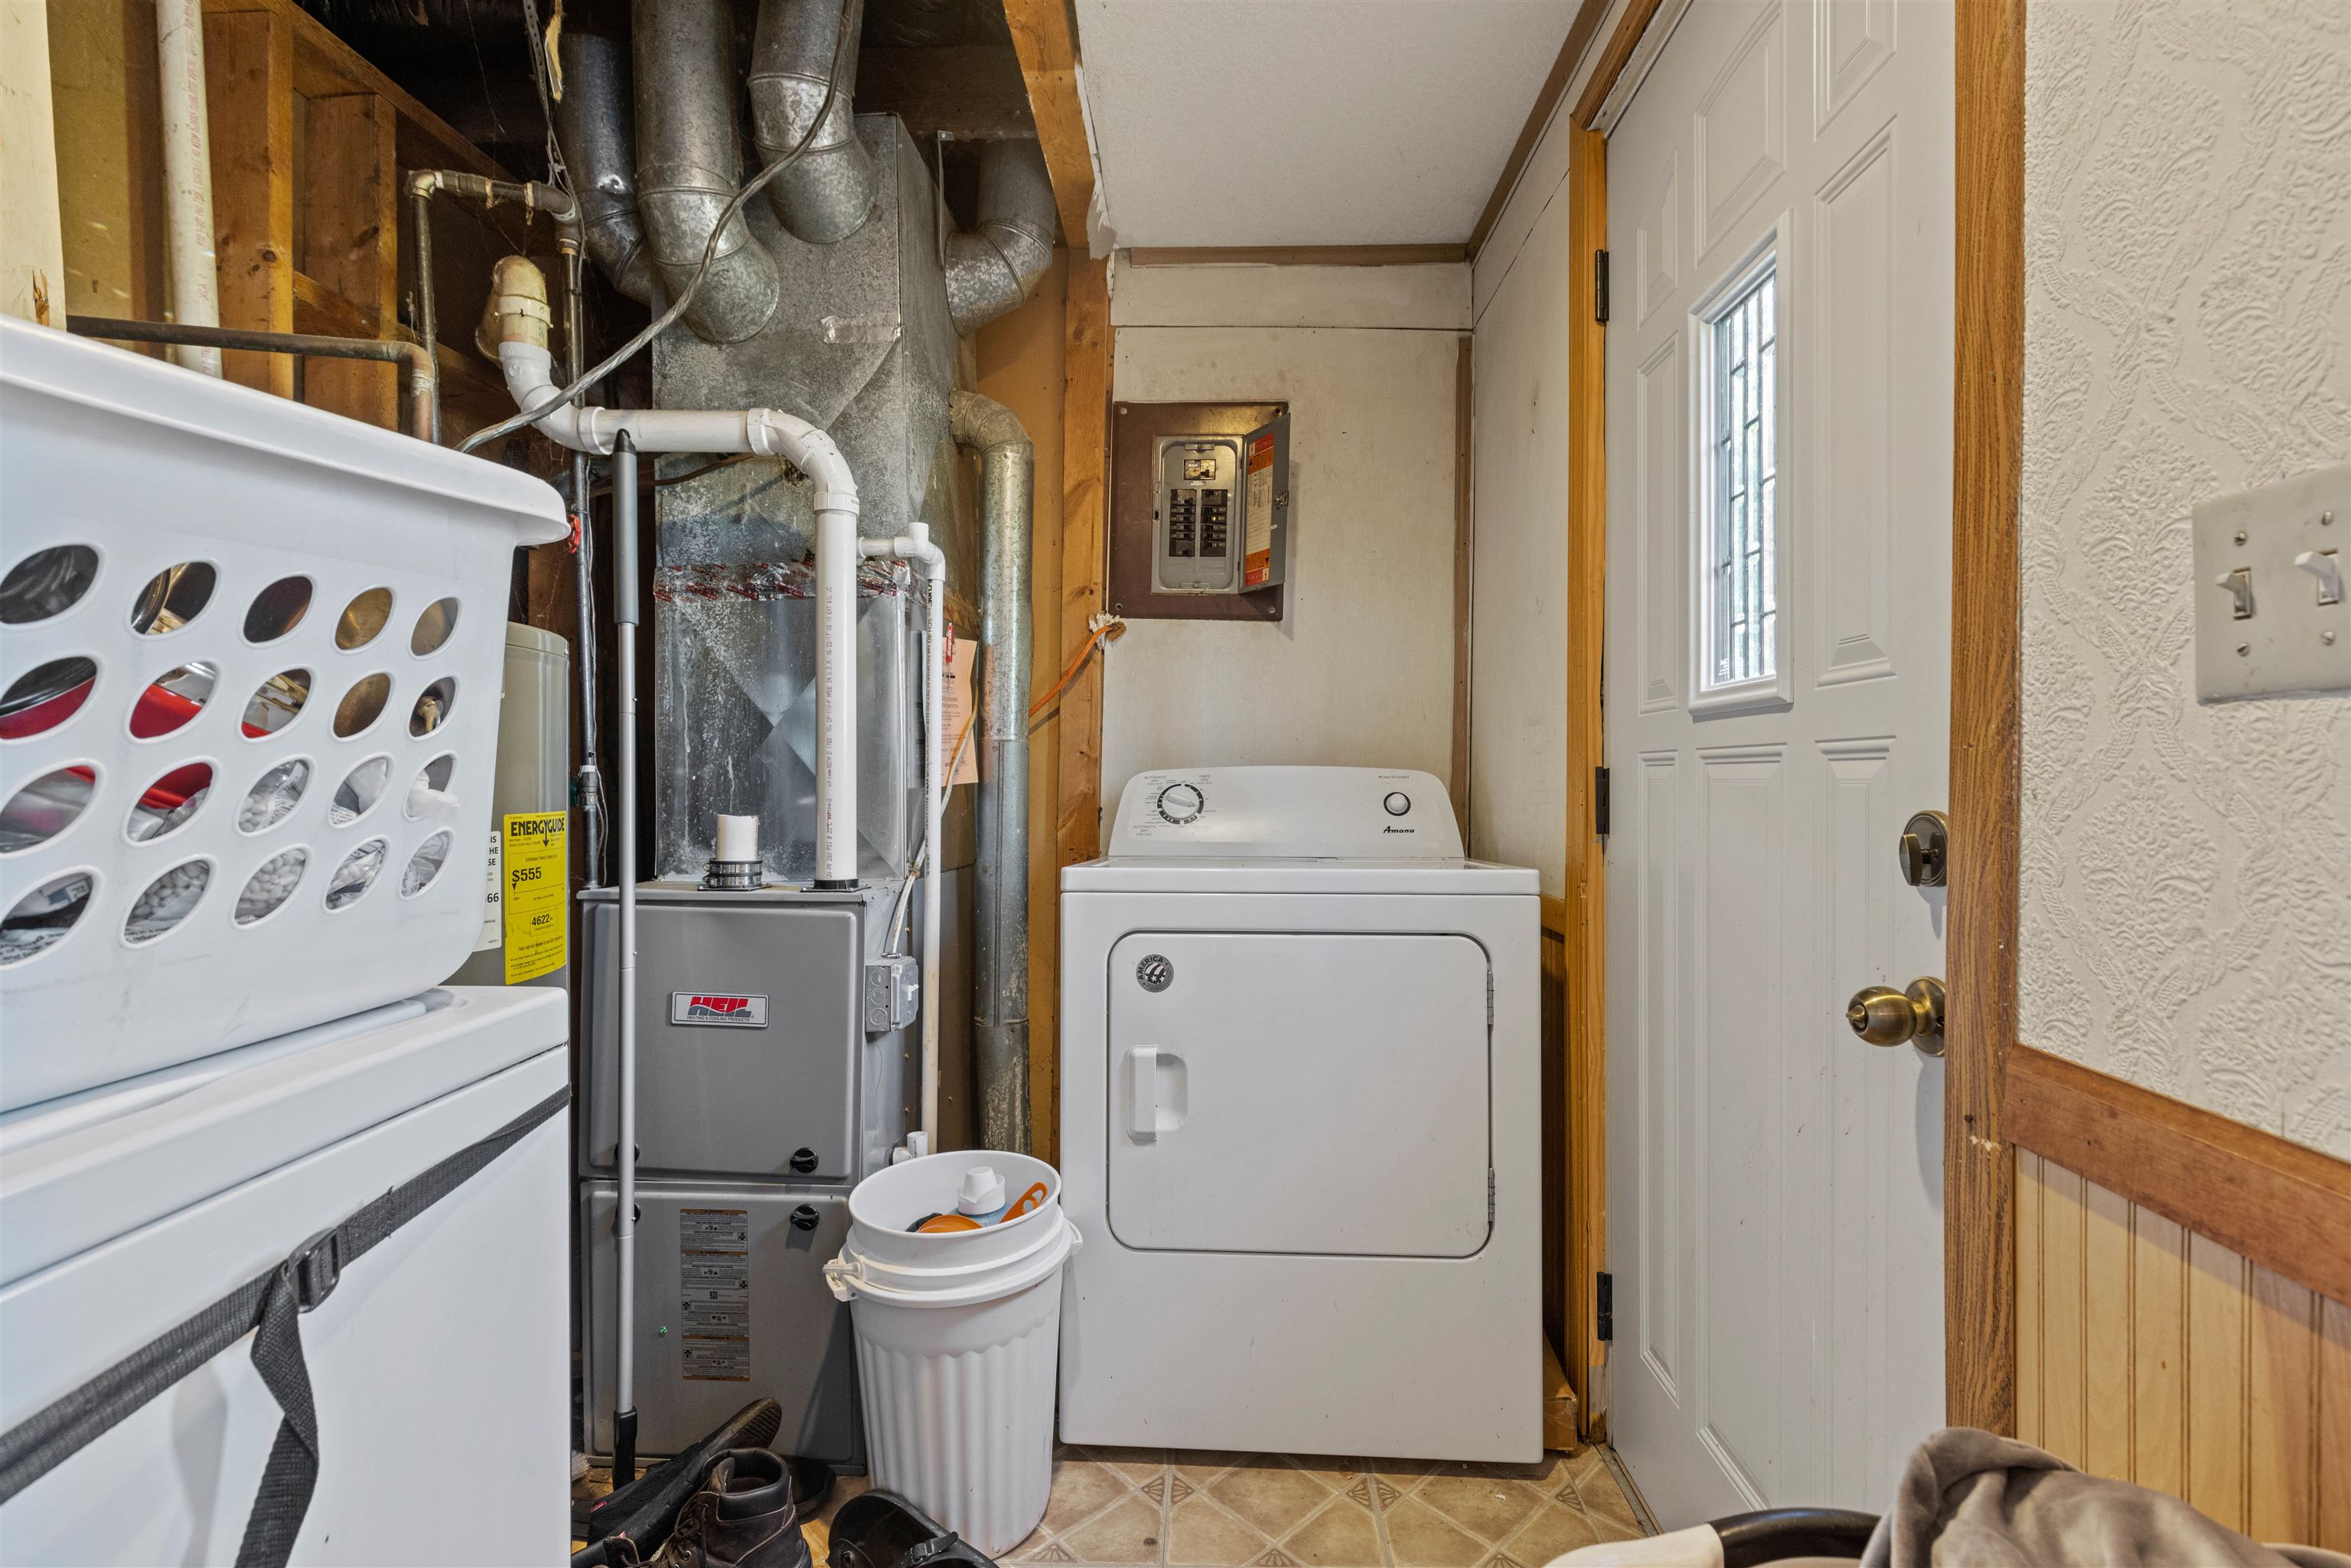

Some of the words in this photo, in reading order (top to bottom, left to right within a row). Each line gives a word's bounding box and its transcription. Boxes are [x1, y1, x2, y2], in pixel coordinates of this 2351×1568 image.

[928, 633, 932, 643] 40
[512, 866, 542, 882] $555
[485, 893, 499, 903] 66
[531, 914, 550, 926] 4622
[1138, 956, 1163, 980] AMERICA
[688, 996, 752, 1018] HEIL
